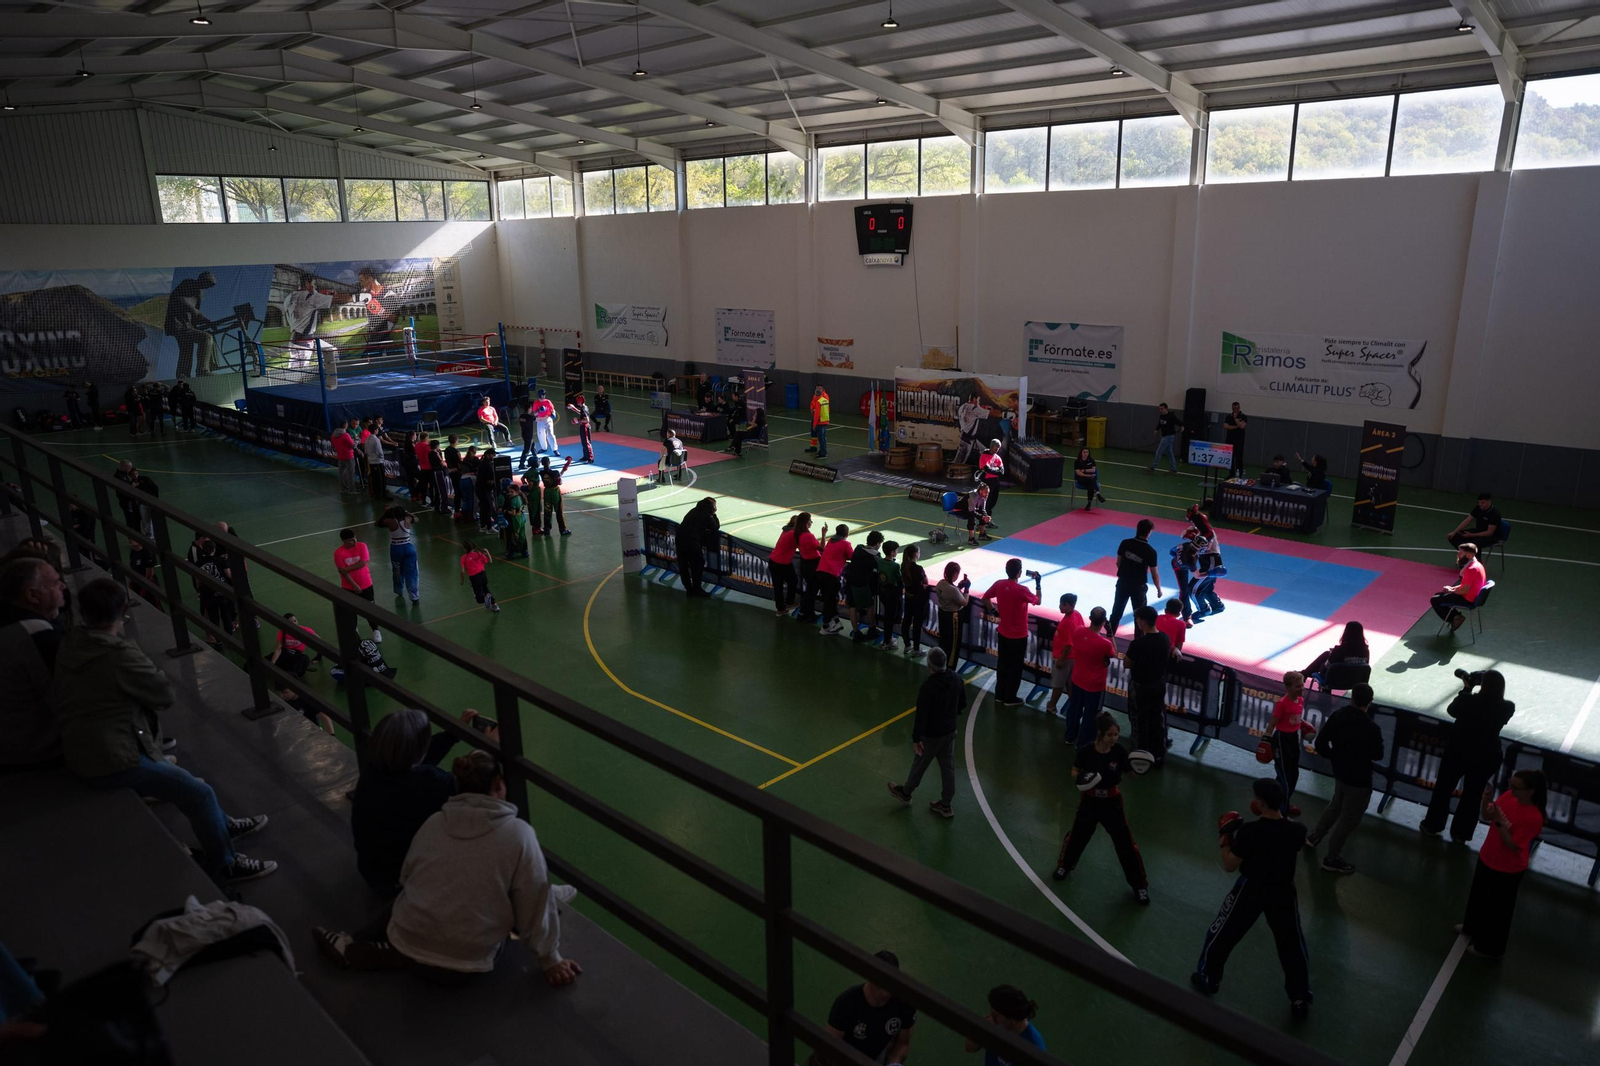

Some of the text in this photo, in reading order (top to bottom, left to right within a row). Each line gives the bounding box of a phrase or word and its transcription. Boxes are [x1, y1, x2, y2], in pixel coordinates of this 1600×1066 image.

[869, 217, 876, 230] 0
[897, 216, 905, 229] 0
[865, 256, 893, 264] caixanova
[600, 310, 627, 325] Ramos
[1233, 344, 1306, 369] Ramos
[1325, 344, 1355, 359] Super
[1269, 381, 1321, 395] CLIMALIT
[1324, 385, 1352, 397] PLUS
[897, 389, 960, 420] KICKBOXING
[1372, 428, 1389, 437] ÁREA
[1191, 452, 1230, 466] 1:37 2/2
[1224, 487, 1253, 496] TROFEO
[1241, 686, 1282, 702] TROFE
[1210, 893, 1235, 934] CENTURY
